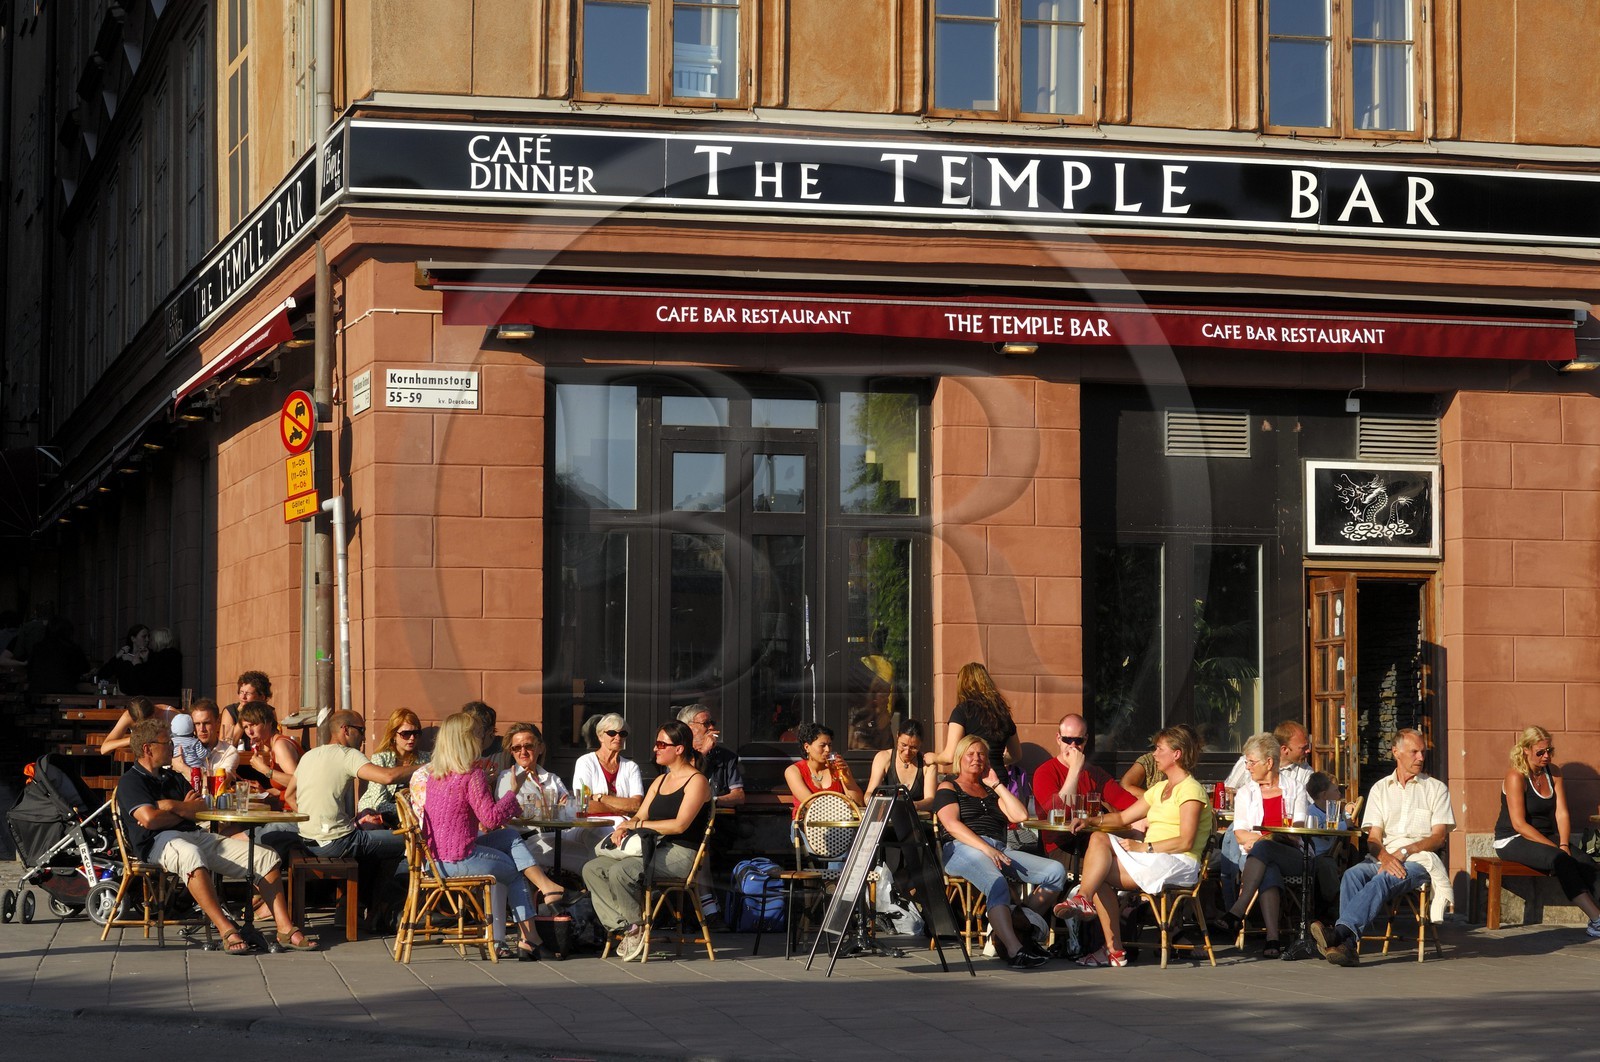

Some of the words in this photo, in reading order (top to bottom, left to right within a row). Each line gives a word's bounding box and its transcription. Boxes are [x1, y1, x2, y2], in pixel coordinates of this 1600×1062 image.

[468, 134, 551, 164] CAFÉ
[470, 162, 597, 194] DINNER
[694, 144, 822, 200] THE
[880, 153, 1191, 214] TEMPLE
[1290, 170, 1440, 226] BAR
[194, 282, 213, 323] THE
[218, 220, 264, 302] TEMPLE
[276, 181, 304, 248] BAR
[656, 306, 699, 322] CAFE
[703, 307, 737, 323] BAR
[742, 308, 851, 324] RESTAURANT
[944, 313, 984, 333] THE
[989, 315, 1065, 335] TEMPLE
[1070, 318, 1111, 337] BAR
[1201, 323, 1242, 339] CAFE
[1246, 325, 1278, 342] BAR
[1281, 327, 1385, 344] RESTAURANT
[390, 372, 471, 388] Kornhamnstorg
[389, 391, 422, 403] 55-59
[81, 847, 95, 882] RACER
